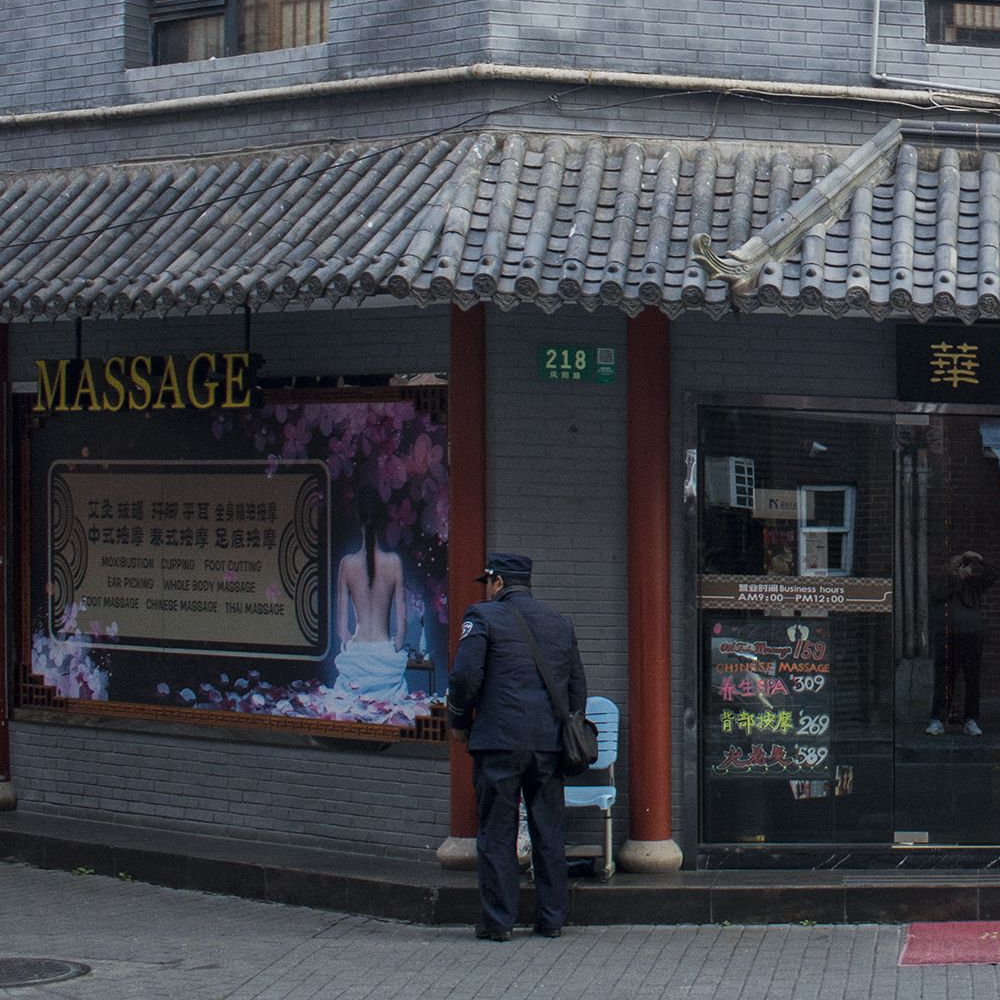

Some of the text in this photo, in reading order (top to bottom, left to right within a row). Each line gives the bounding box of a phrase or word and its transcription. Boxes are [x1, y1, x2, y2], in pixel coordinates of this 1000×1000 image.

[545, 348, 587, 370] 218
[32, 351, 251, 412] MASSAGE
[88, 499, 114, 520] 艾灸
[88, 526, 277, 550] 中式按摩 泰式按摩 足底按摩
[102, 556, 262, 573] MOXIBUSTION CUPPING FOOT CUTTING
[107, 576, 256, 593] EAR PICKING WHOLE BODY MASSAGE
[779, 584, 816, 594] Business
[819, 585, 845, 594] hours
[82, 595, 285, 616] FOOT MASSAGE CHINESE MASSAGE THAI MASSAGE
[793, 639, 827, 661] 159
[715, 662, 830, 673] CHINESE MASSAGE
[720, 709, 794, 735] 背部按摩
